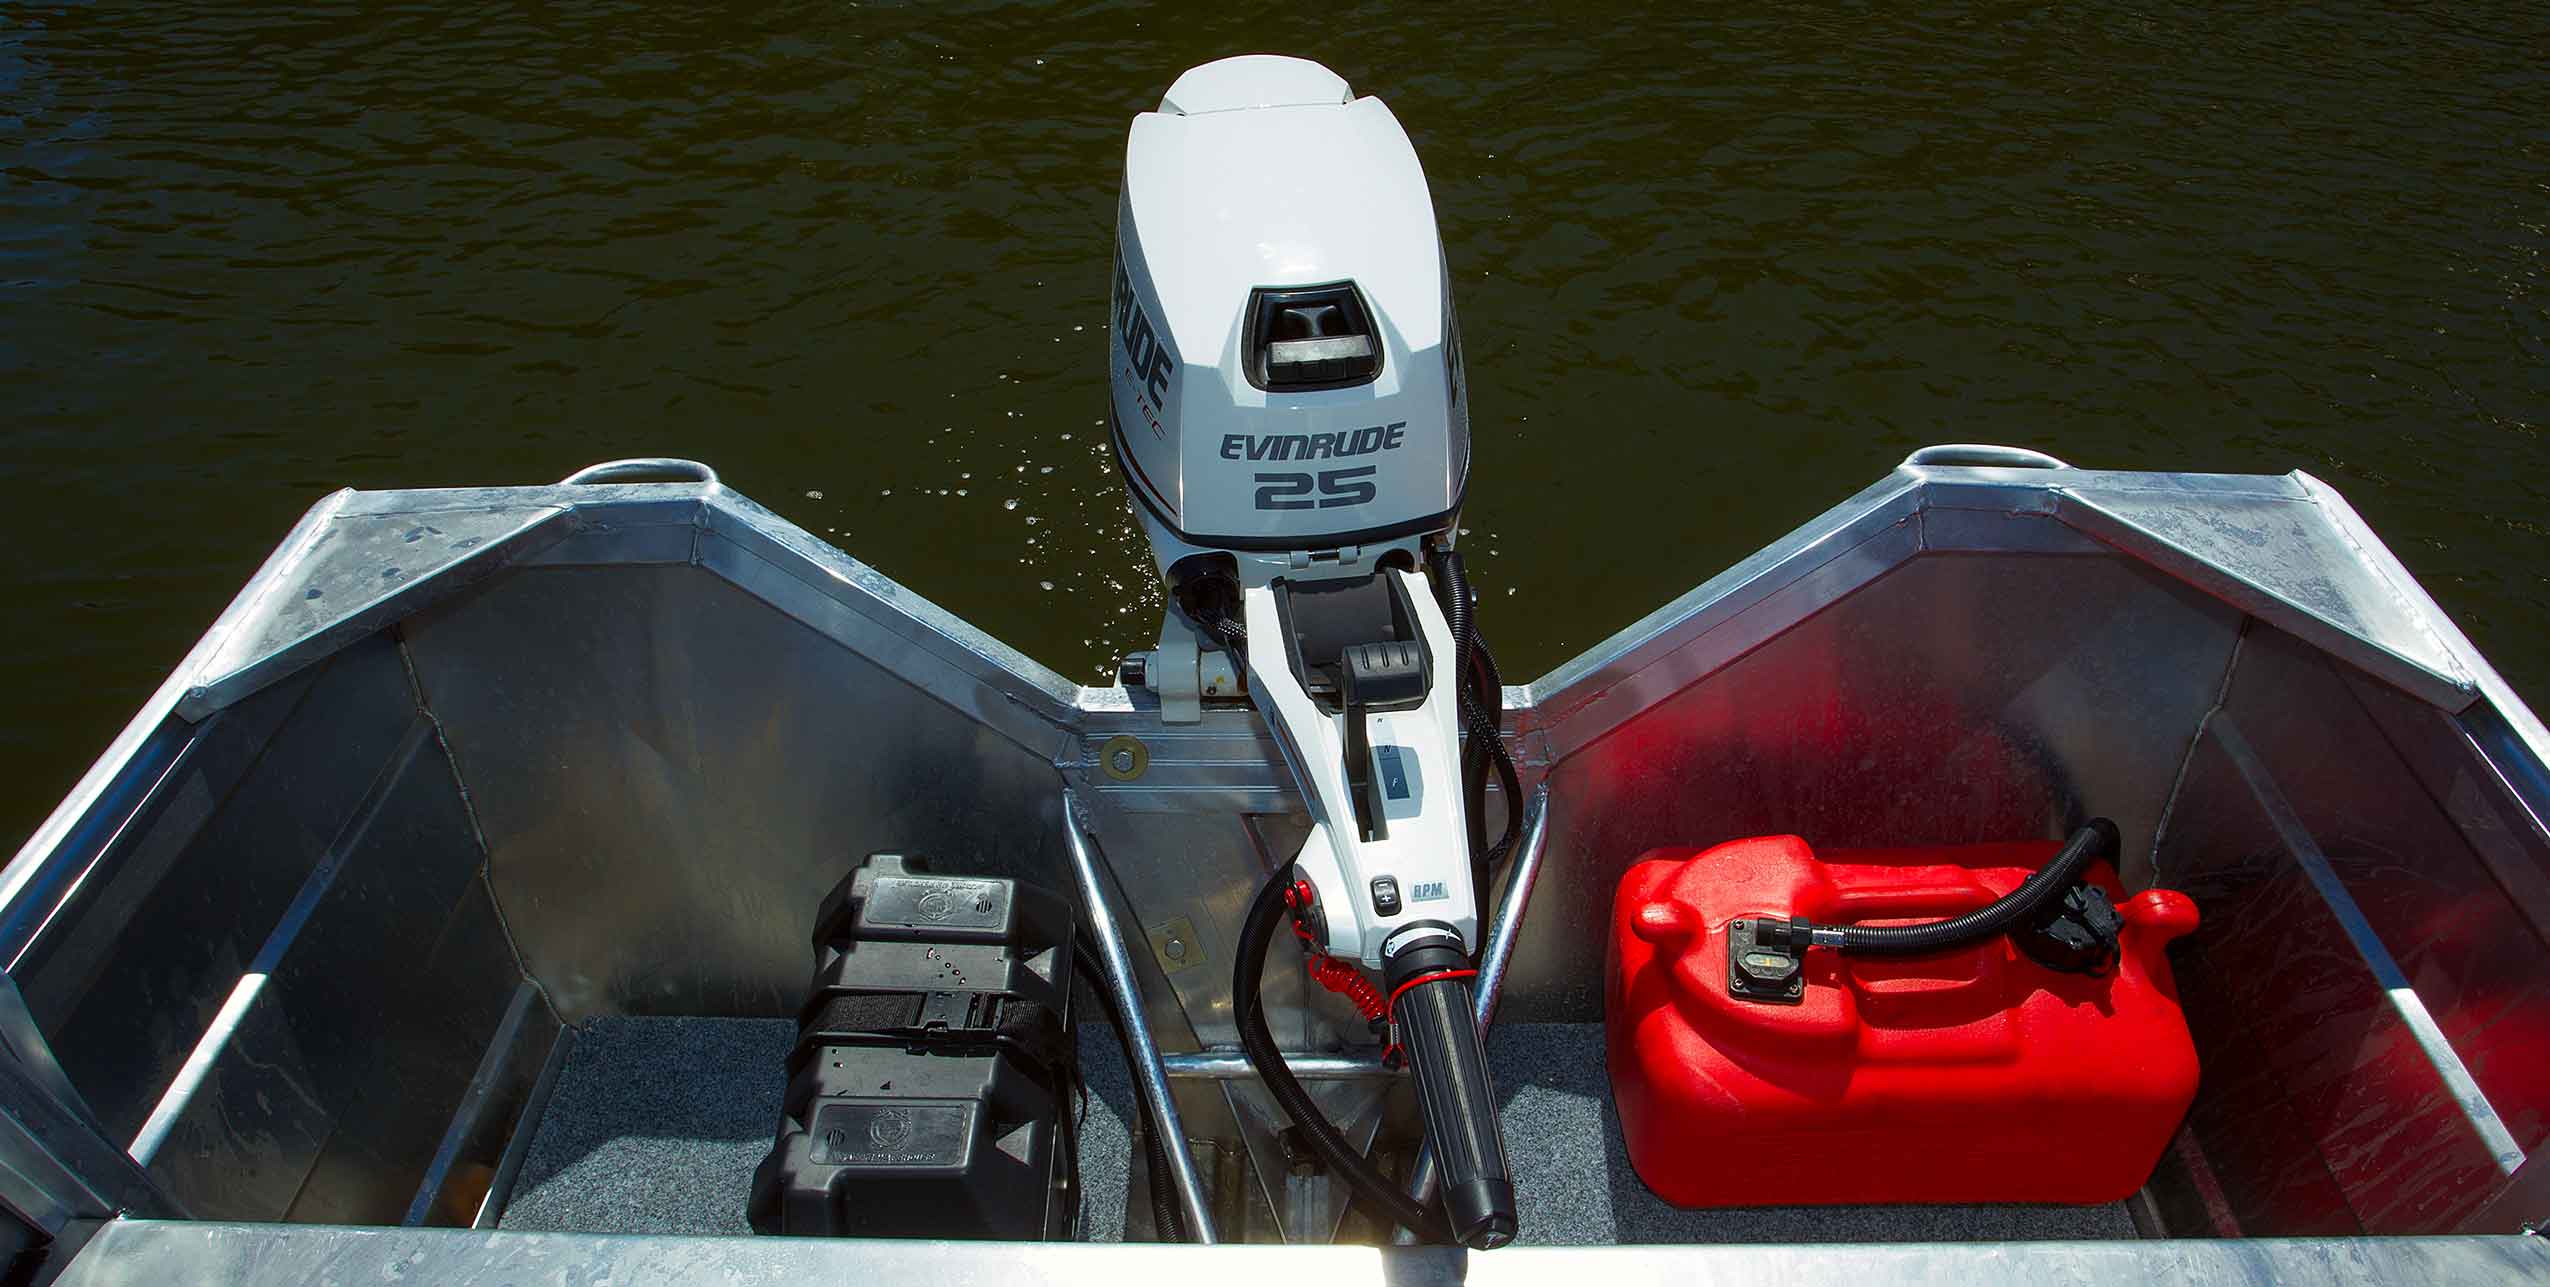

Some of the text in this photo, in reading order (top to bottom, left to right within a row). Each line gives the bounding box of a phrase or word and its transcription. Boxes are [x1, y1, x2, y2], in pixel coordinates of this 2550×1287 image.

[1219, 421, 1407, 461] EVINRUDE
[1254, 465, 1377, 510] 25
[1414, 882, 1442, 898] RPM
